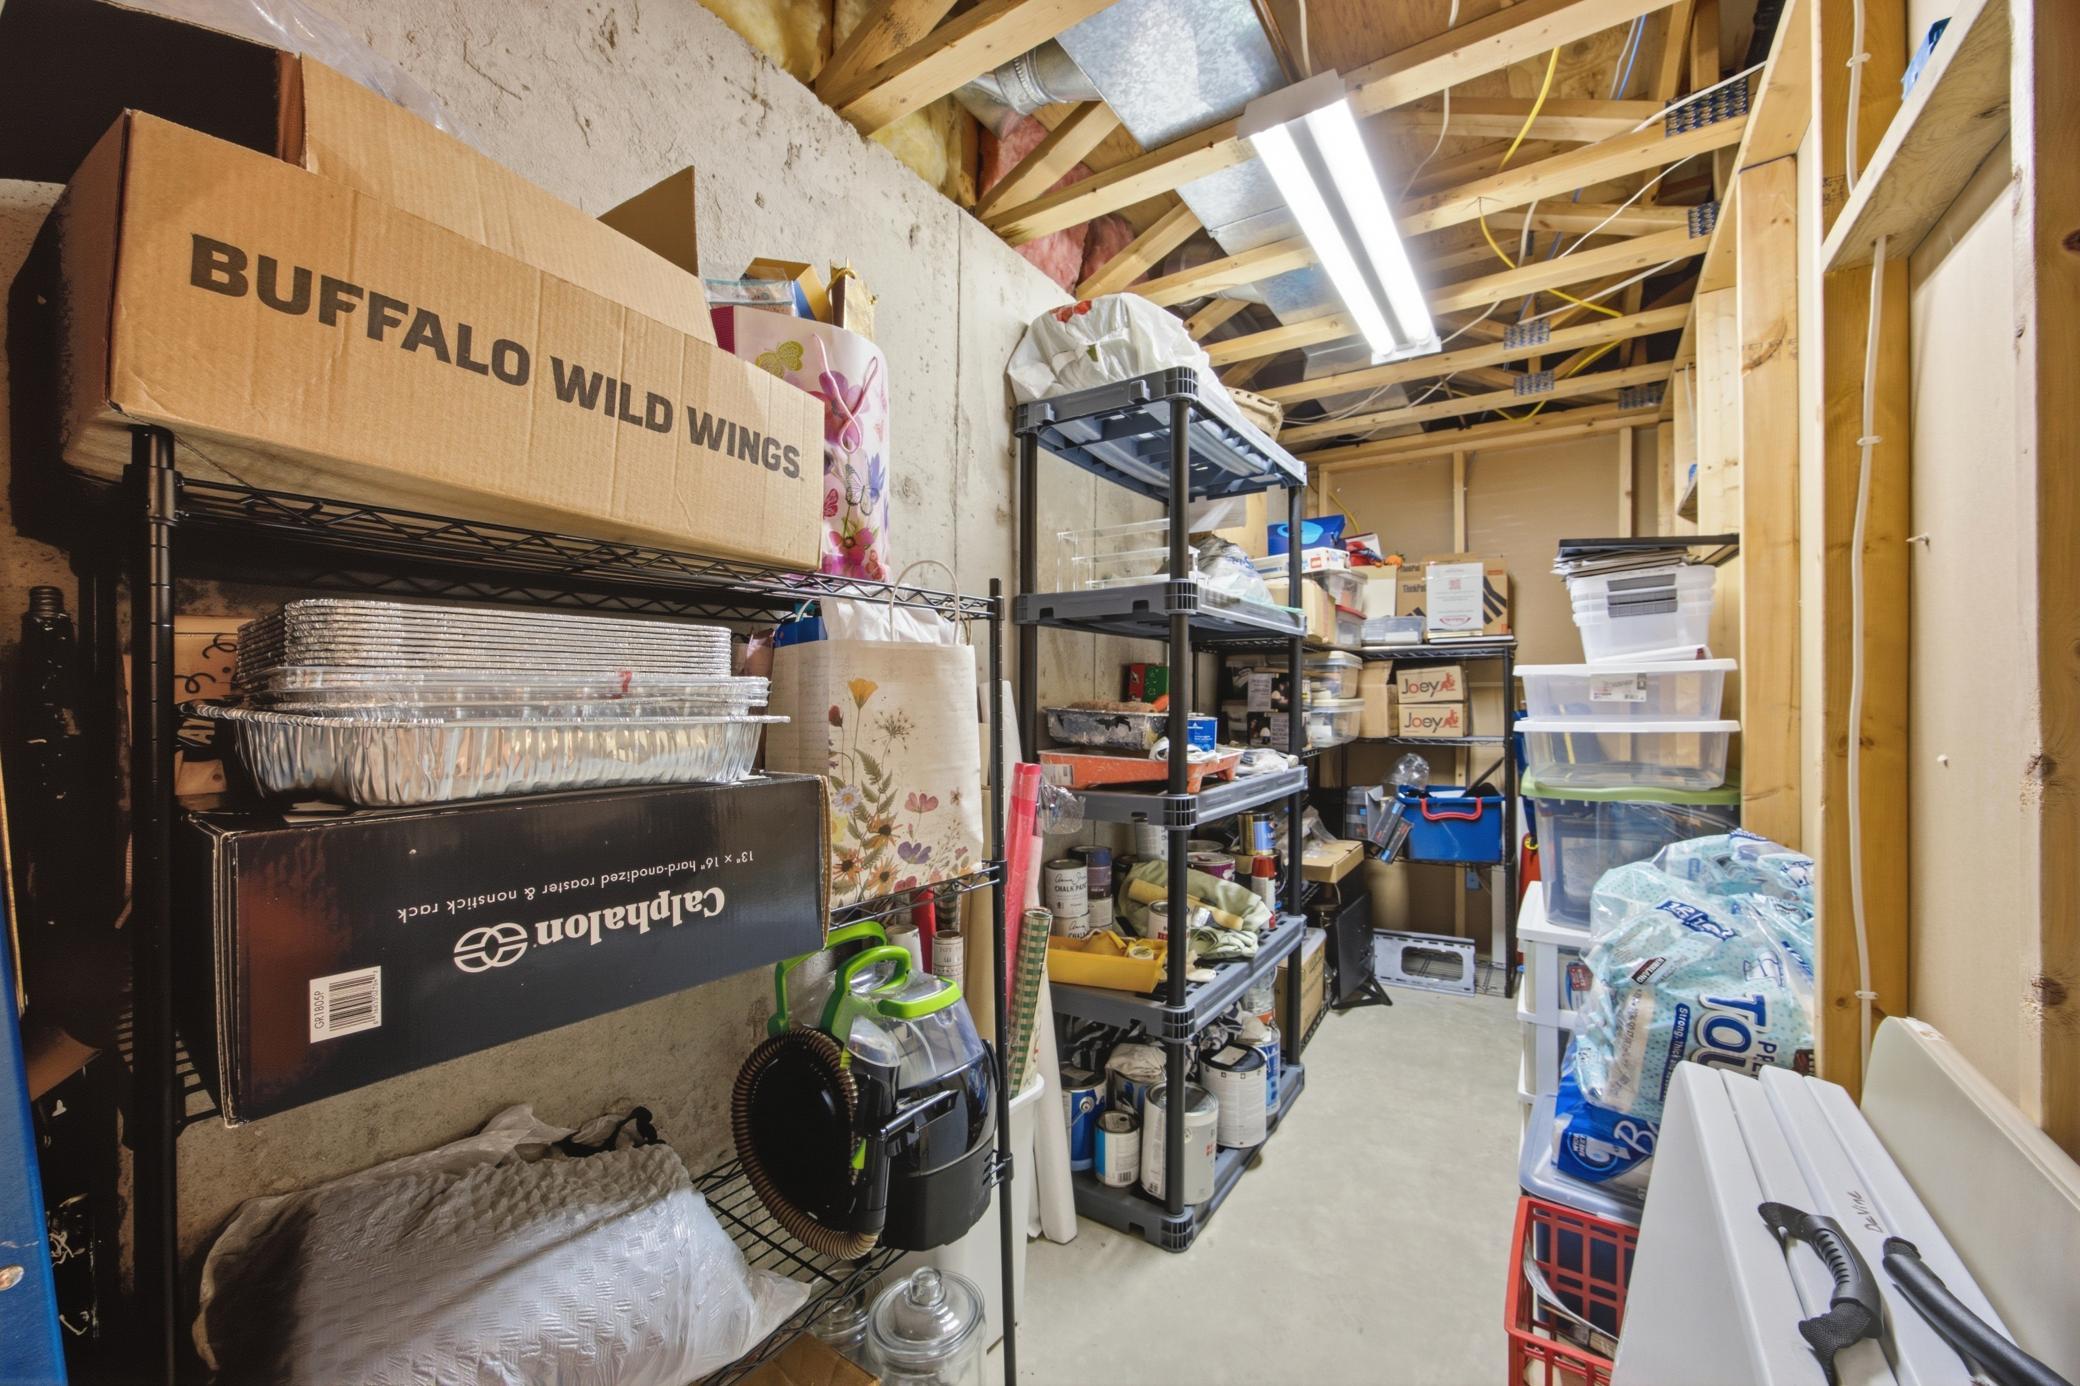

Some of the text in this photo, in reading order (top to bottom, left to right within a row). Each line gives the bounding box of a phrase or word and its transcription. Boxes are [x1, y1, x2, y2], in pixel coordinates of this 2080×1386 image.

[189, 233, 801, 480] BUFFALO WILD WINGS
[1401, 678, 1440, 698] Joey
[1404, 712, 1443, 734] Joey
[700, 856, 719, 870] 16"
[736, 850, 754, 863] 13"
[600, 860, 696, 888] hard-anodized
[523, 886, 536, 901] &
[541, 877, 595, 895] roaster
[396, 902, 439, 924] rack
[446, 889, 517, 915] nonstick
[534, 886, 725, 947] Calphalon
[313, 990, 325, 1029] GR1805P
[1673, 1006, 1688, 1039] Strong,
